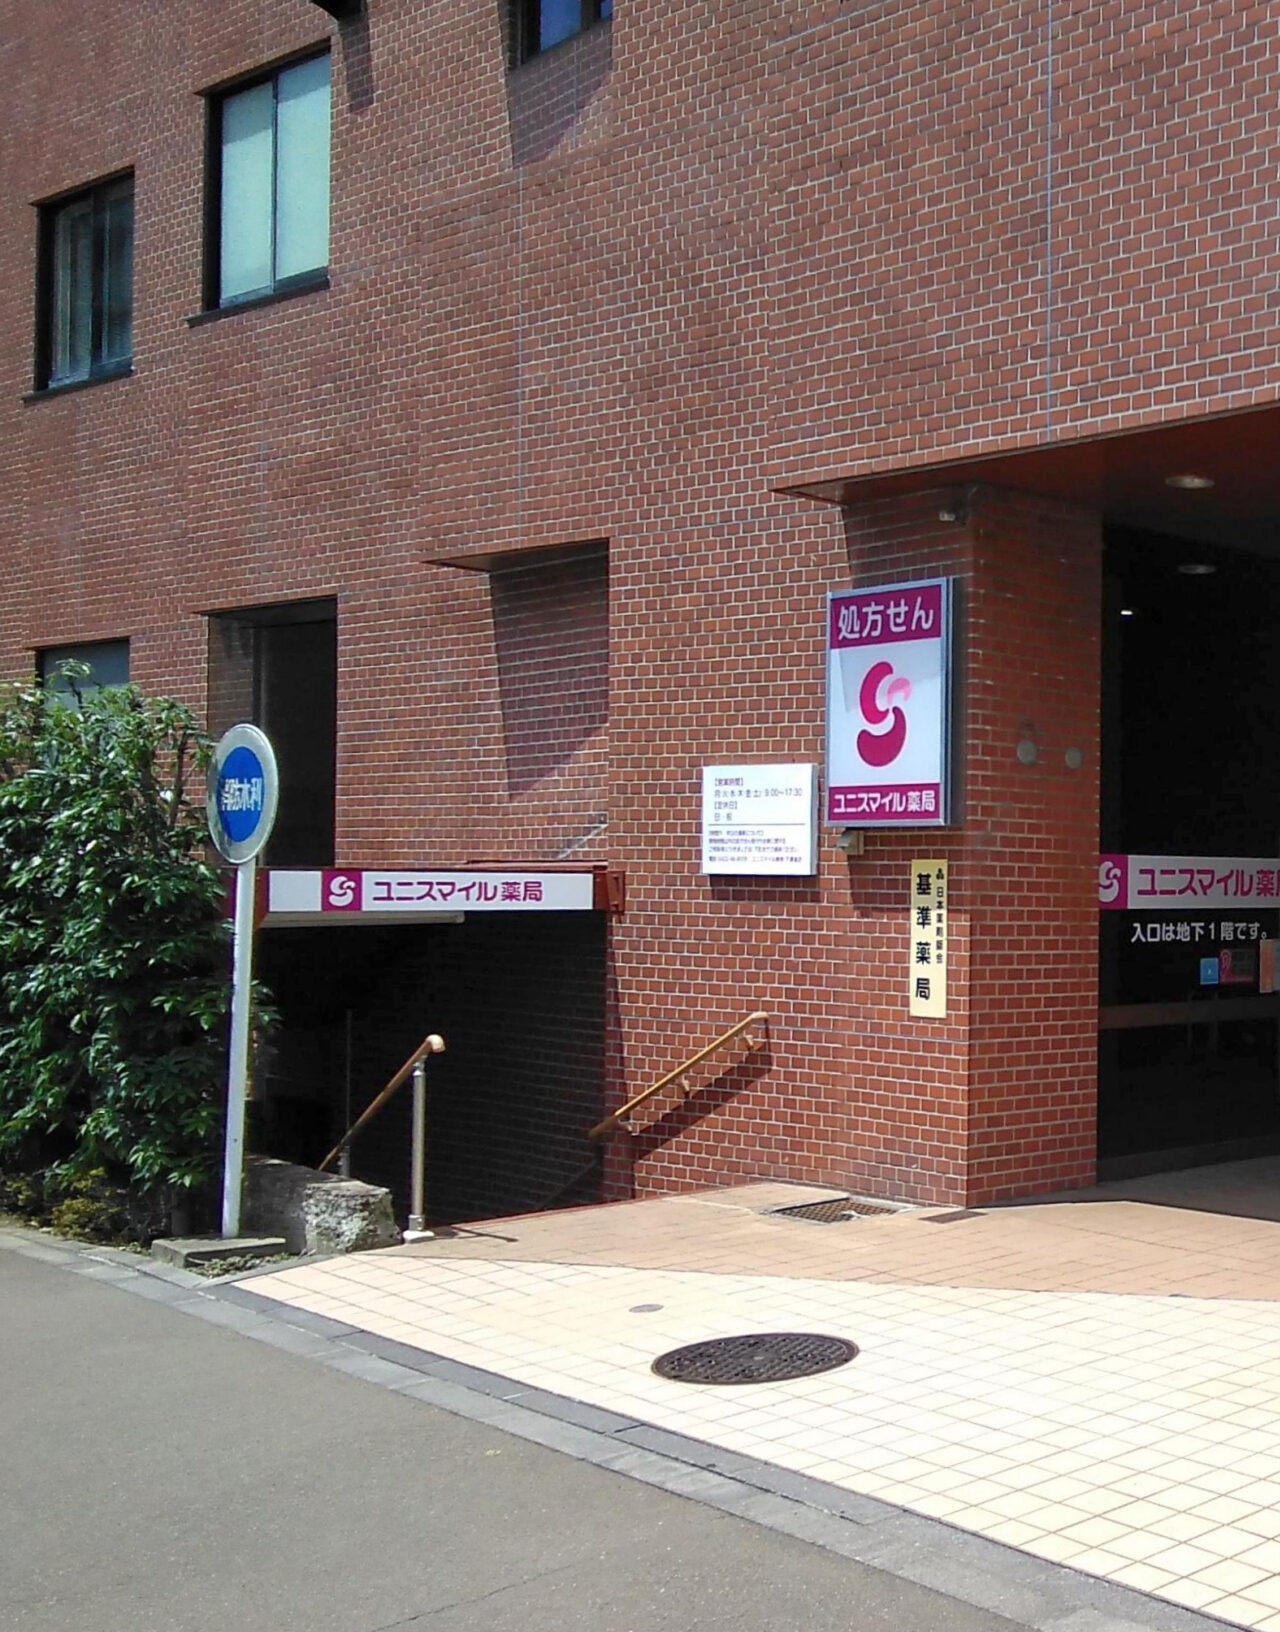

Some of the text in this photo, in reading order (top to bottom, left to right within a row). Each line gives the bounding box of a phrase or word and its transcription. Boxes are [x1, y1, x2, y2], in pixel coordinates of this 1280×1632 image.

[837, 596, 934, 641] 処方せん
[833, 789, 936, 813] ユニスマイル薬局
[372, 880, 544, 903] ユニスマイル薬局
[915, 872, 932, 1001] 基準薬局
